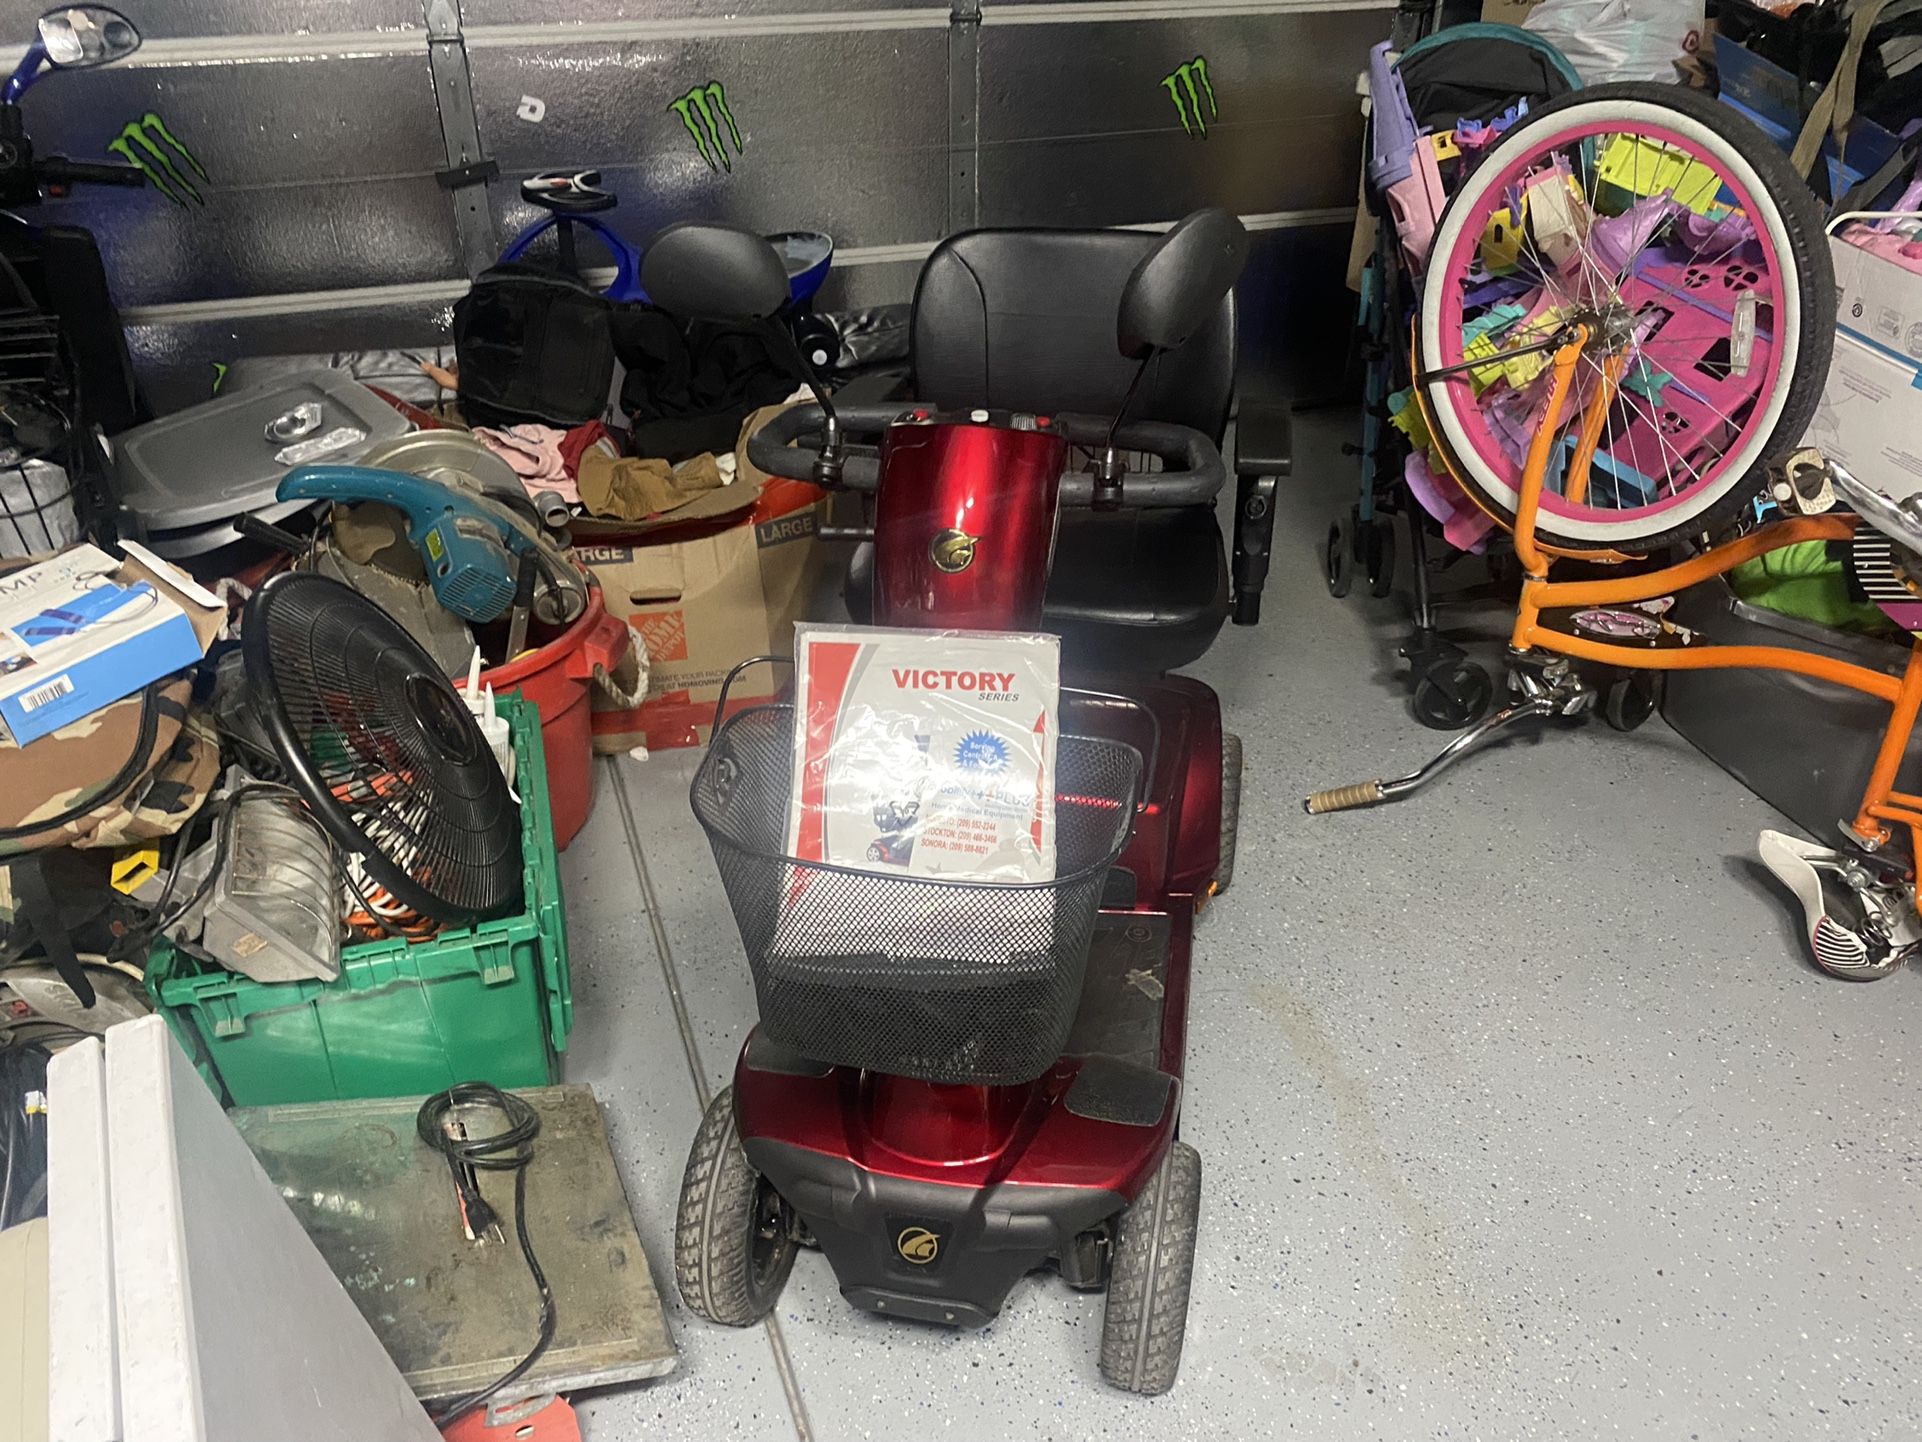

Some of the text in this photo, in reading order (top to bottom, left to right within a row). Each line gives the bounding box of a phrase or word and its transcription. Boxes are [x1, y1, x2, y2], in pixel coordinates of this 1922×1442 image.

[760, 517, 812, 543] LARGE
[645, 611, 682, 656] OME
[891, 669, 1016, 692] VICTORY
[978, 692, 1020, 702] SERIES
[984, 809, 1024, 820] Equipment
